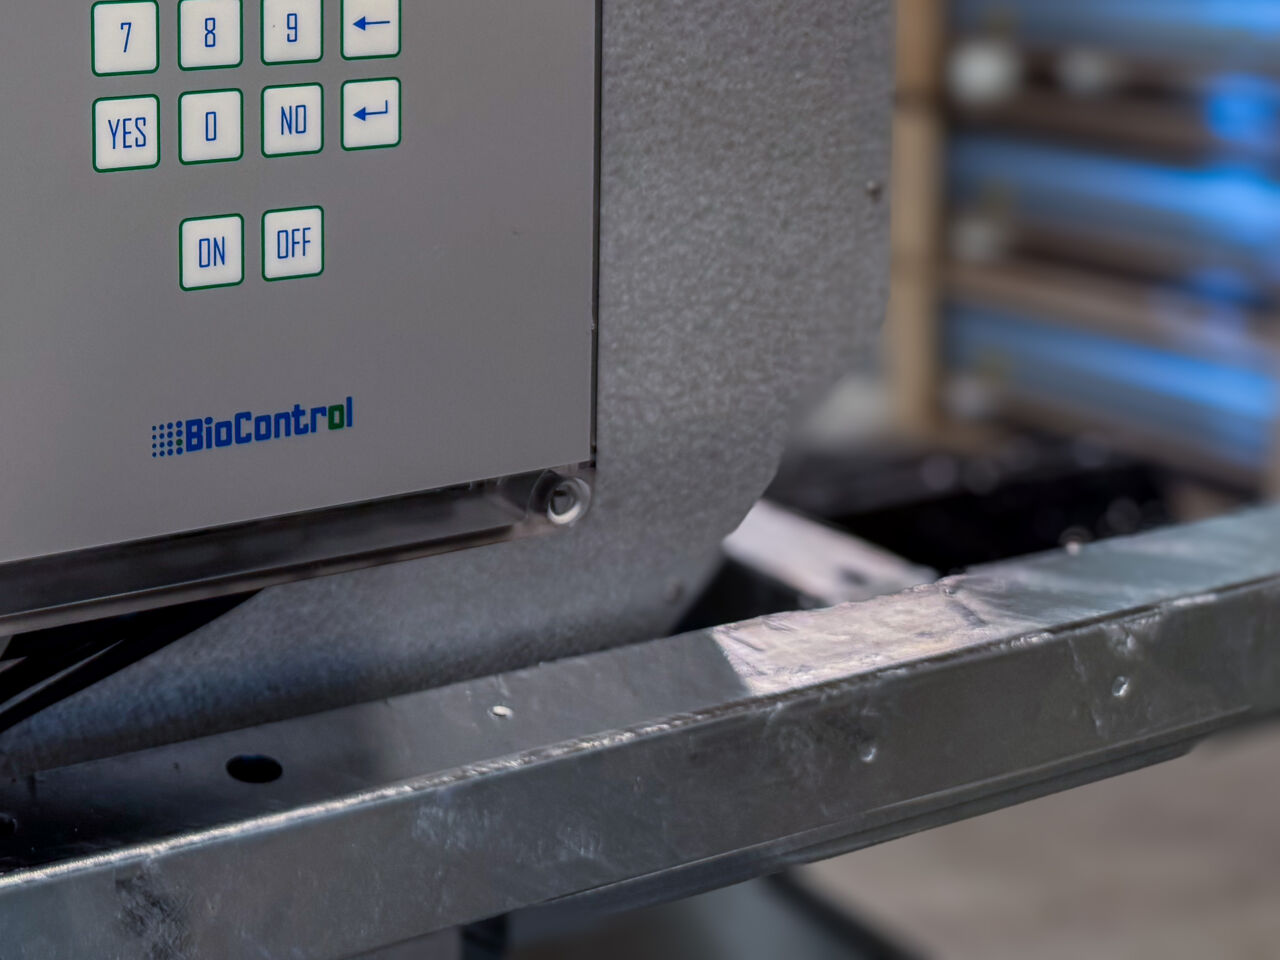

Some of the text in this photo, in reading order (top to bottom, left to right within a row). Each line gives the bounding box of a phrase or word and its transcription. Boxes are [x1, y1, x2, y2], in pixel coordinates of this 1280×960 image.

[119, 21, 132, 53] 7
[204, 17, 217, 49] 8
[286, 12, 299, 43] 9
[108, 116, 147, 150] YES
[205, 111, 218, 142] 0
[280, 104, 308, 136] NO
[198, 236, 227, 269] ON
[276, 227, 312, 260] OFF
[185, 396, 354, 453] BioControl
